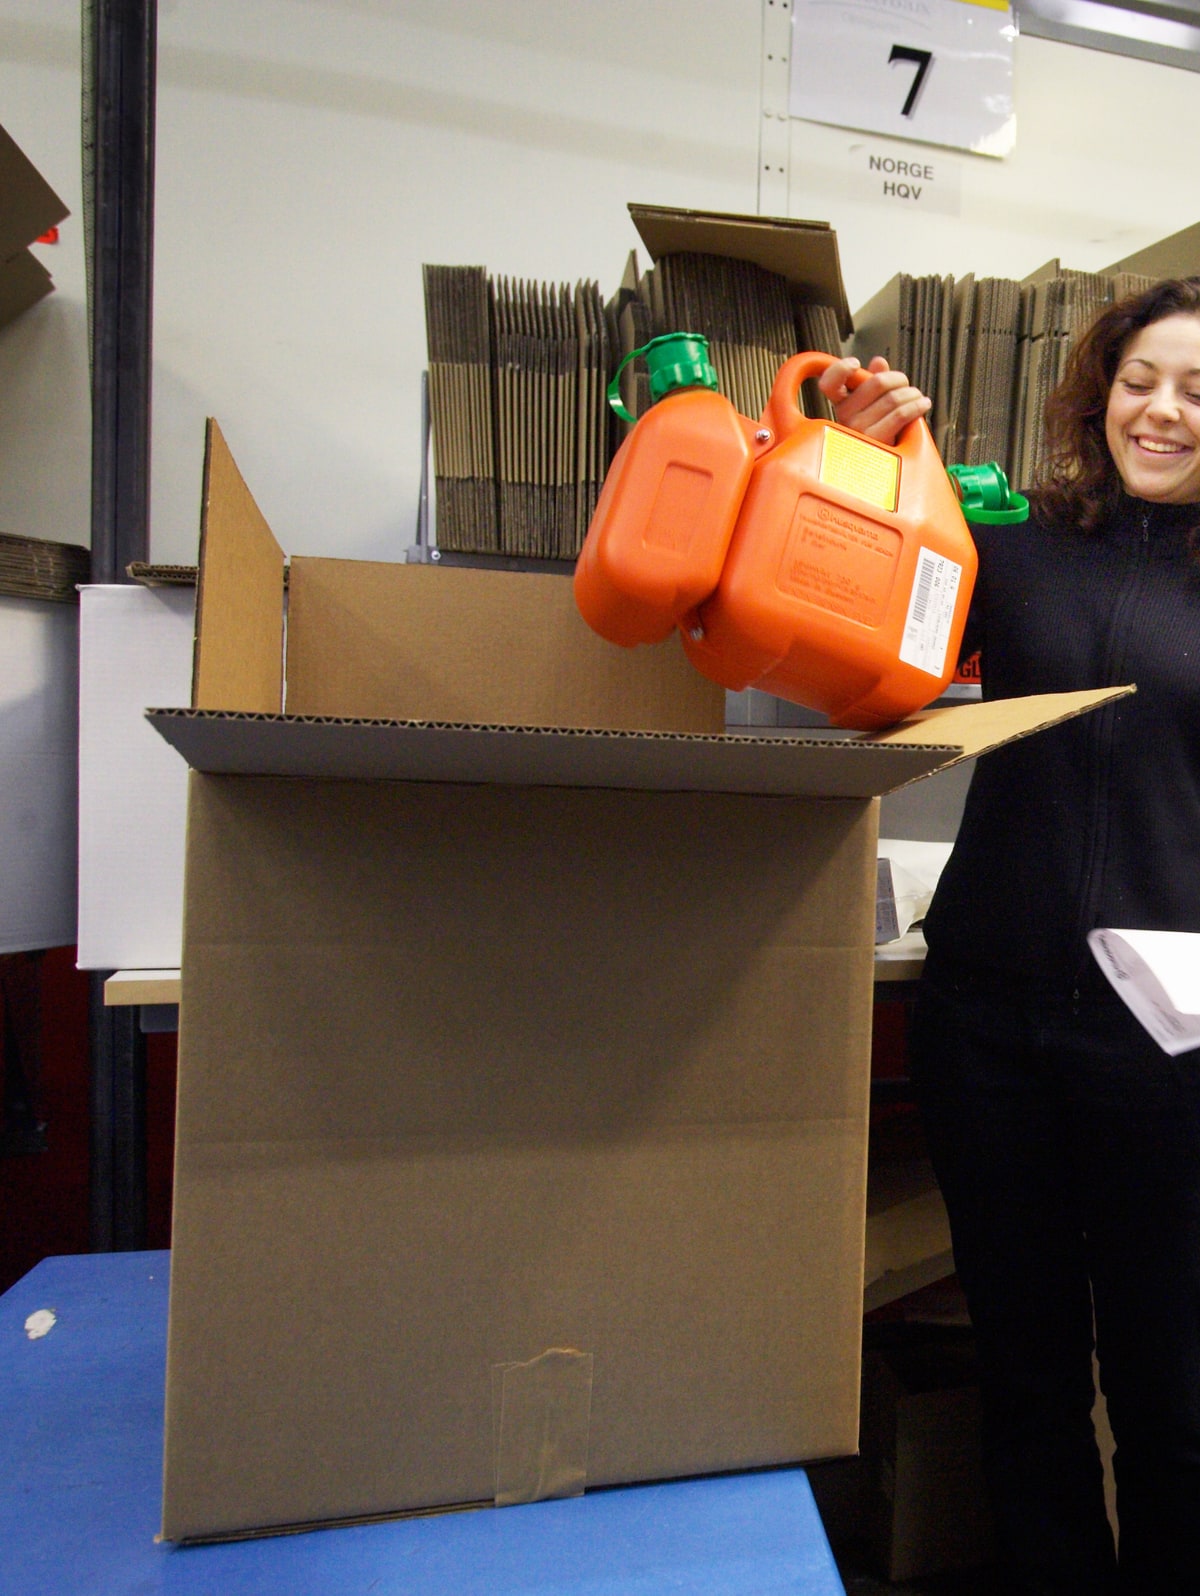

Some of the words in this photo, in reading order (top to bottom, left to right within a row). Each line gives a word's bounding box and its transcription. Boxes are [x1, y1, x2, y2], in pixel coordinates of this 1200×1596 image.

[887, 43, 934, 118] 7
[869, 154, 934, 181] NORGE
[883, 181, 922, 201] HQV
